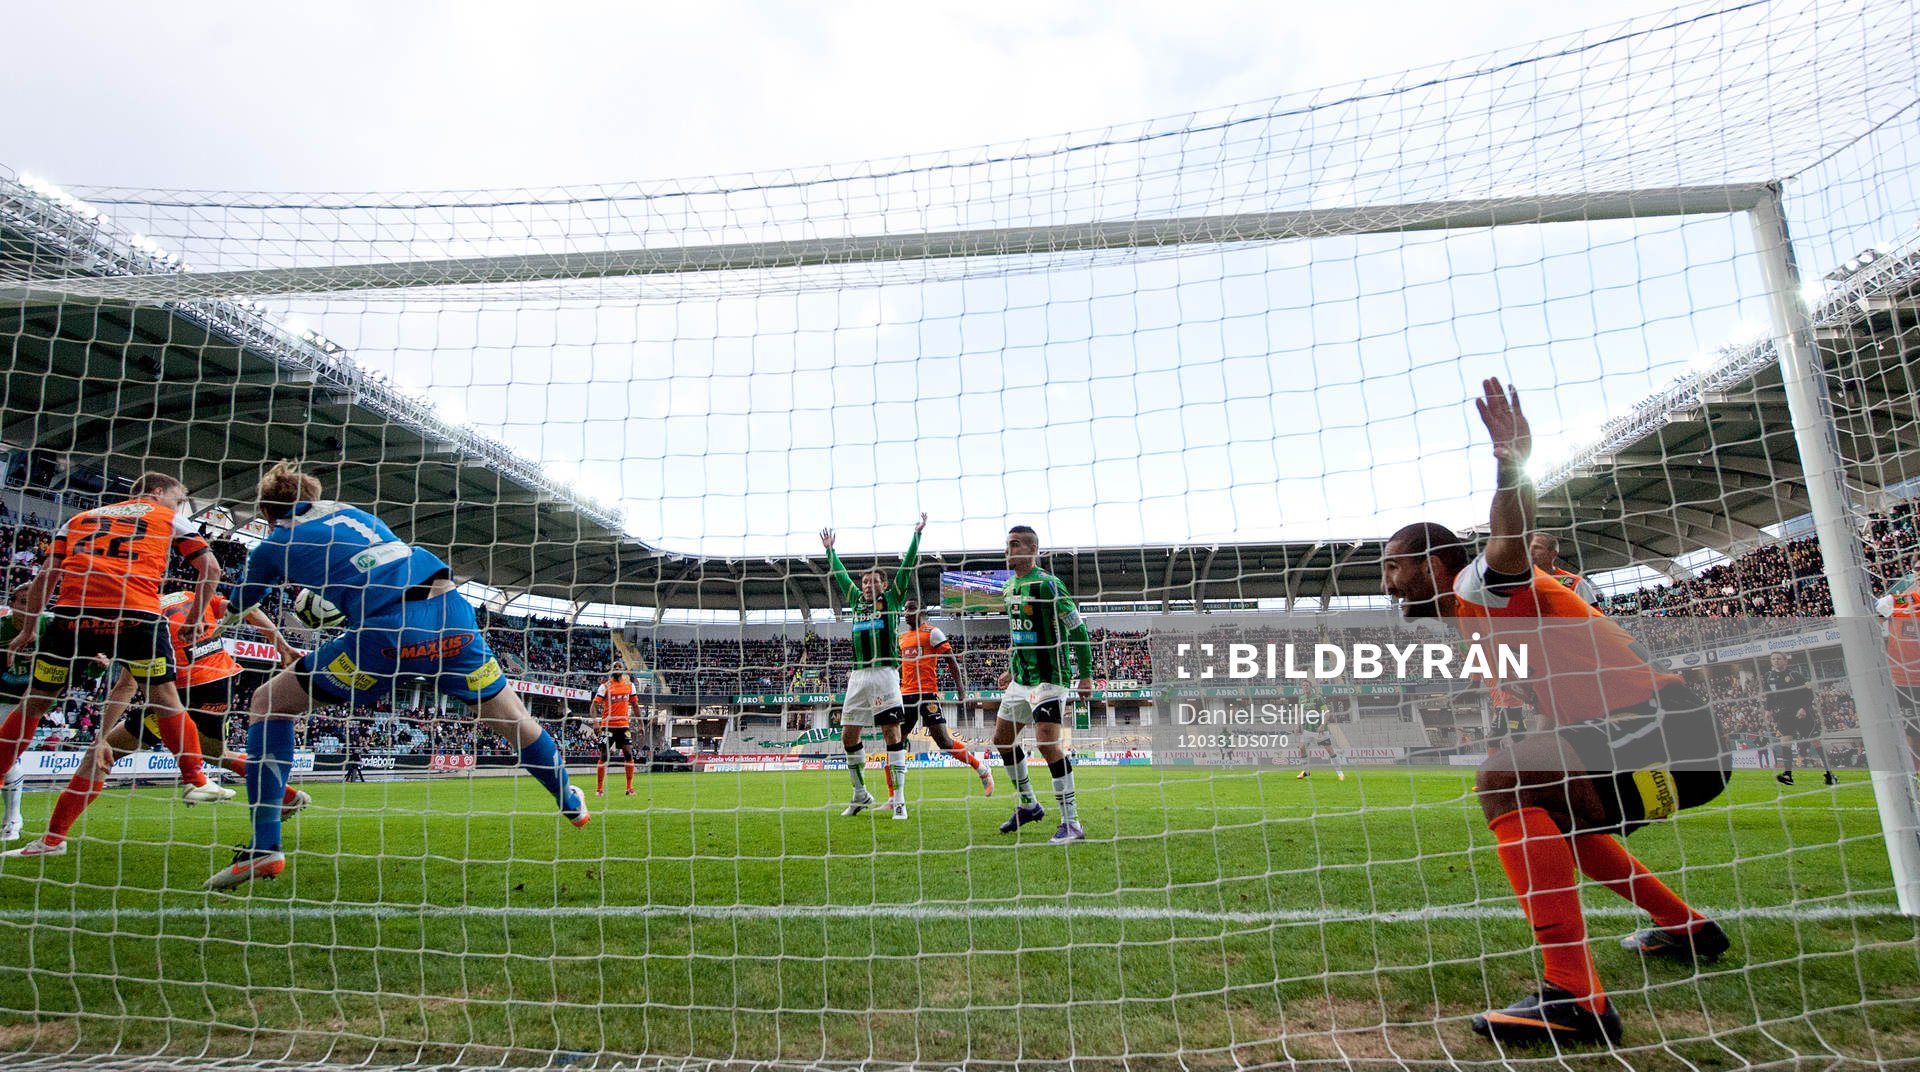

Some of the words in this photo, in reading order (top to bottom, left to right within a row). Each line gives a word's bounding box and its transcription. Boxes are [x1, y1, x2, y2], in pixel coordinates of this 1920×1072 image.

[73, 517, 149, 560] 22
[400, 635, 463, 659] MAXXIS
[517, 681, 531, 692] GT
[542, 684, 556, 695] GT
[565, 687, 577, 698] GT
